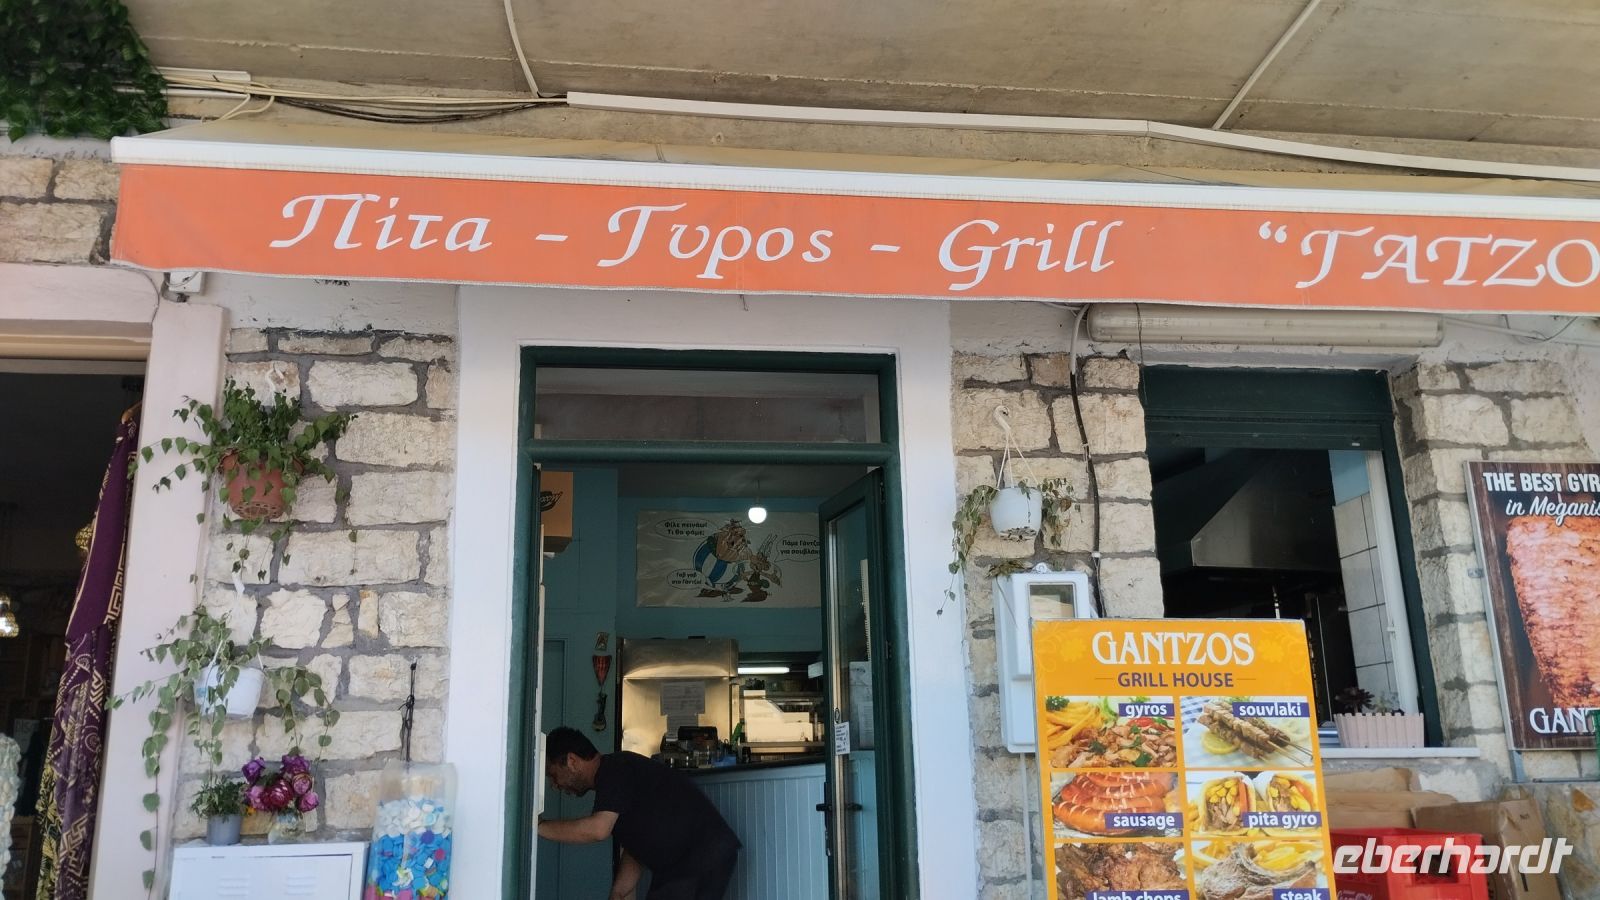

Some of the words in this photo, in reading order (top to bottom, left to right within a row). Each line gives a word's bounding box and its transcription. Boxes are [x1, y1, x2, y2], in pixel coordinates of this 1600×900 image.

[938, 220, 1125, 291] Grill
[1482, 473, 1517, 491] THE
[1519, 473, 1562, 492] BEST
[1505, 499, 1526, 516] in
[1091, 631, 1255, 666] GANTZOS
[1117, 672, 1168, 688] GRILL
[1172, 672, 1234, 688] HOUSE
[1125, 704, 1168, 718] gyros
[1239, 702, 1302, 716] souvlaki
[1113, 815, 1176, 830] sausage
[1248, 811, 1279, 829] pita
[1281, 814, 1318, 829] gyro
[1280, 888, 1322, 900] steak
